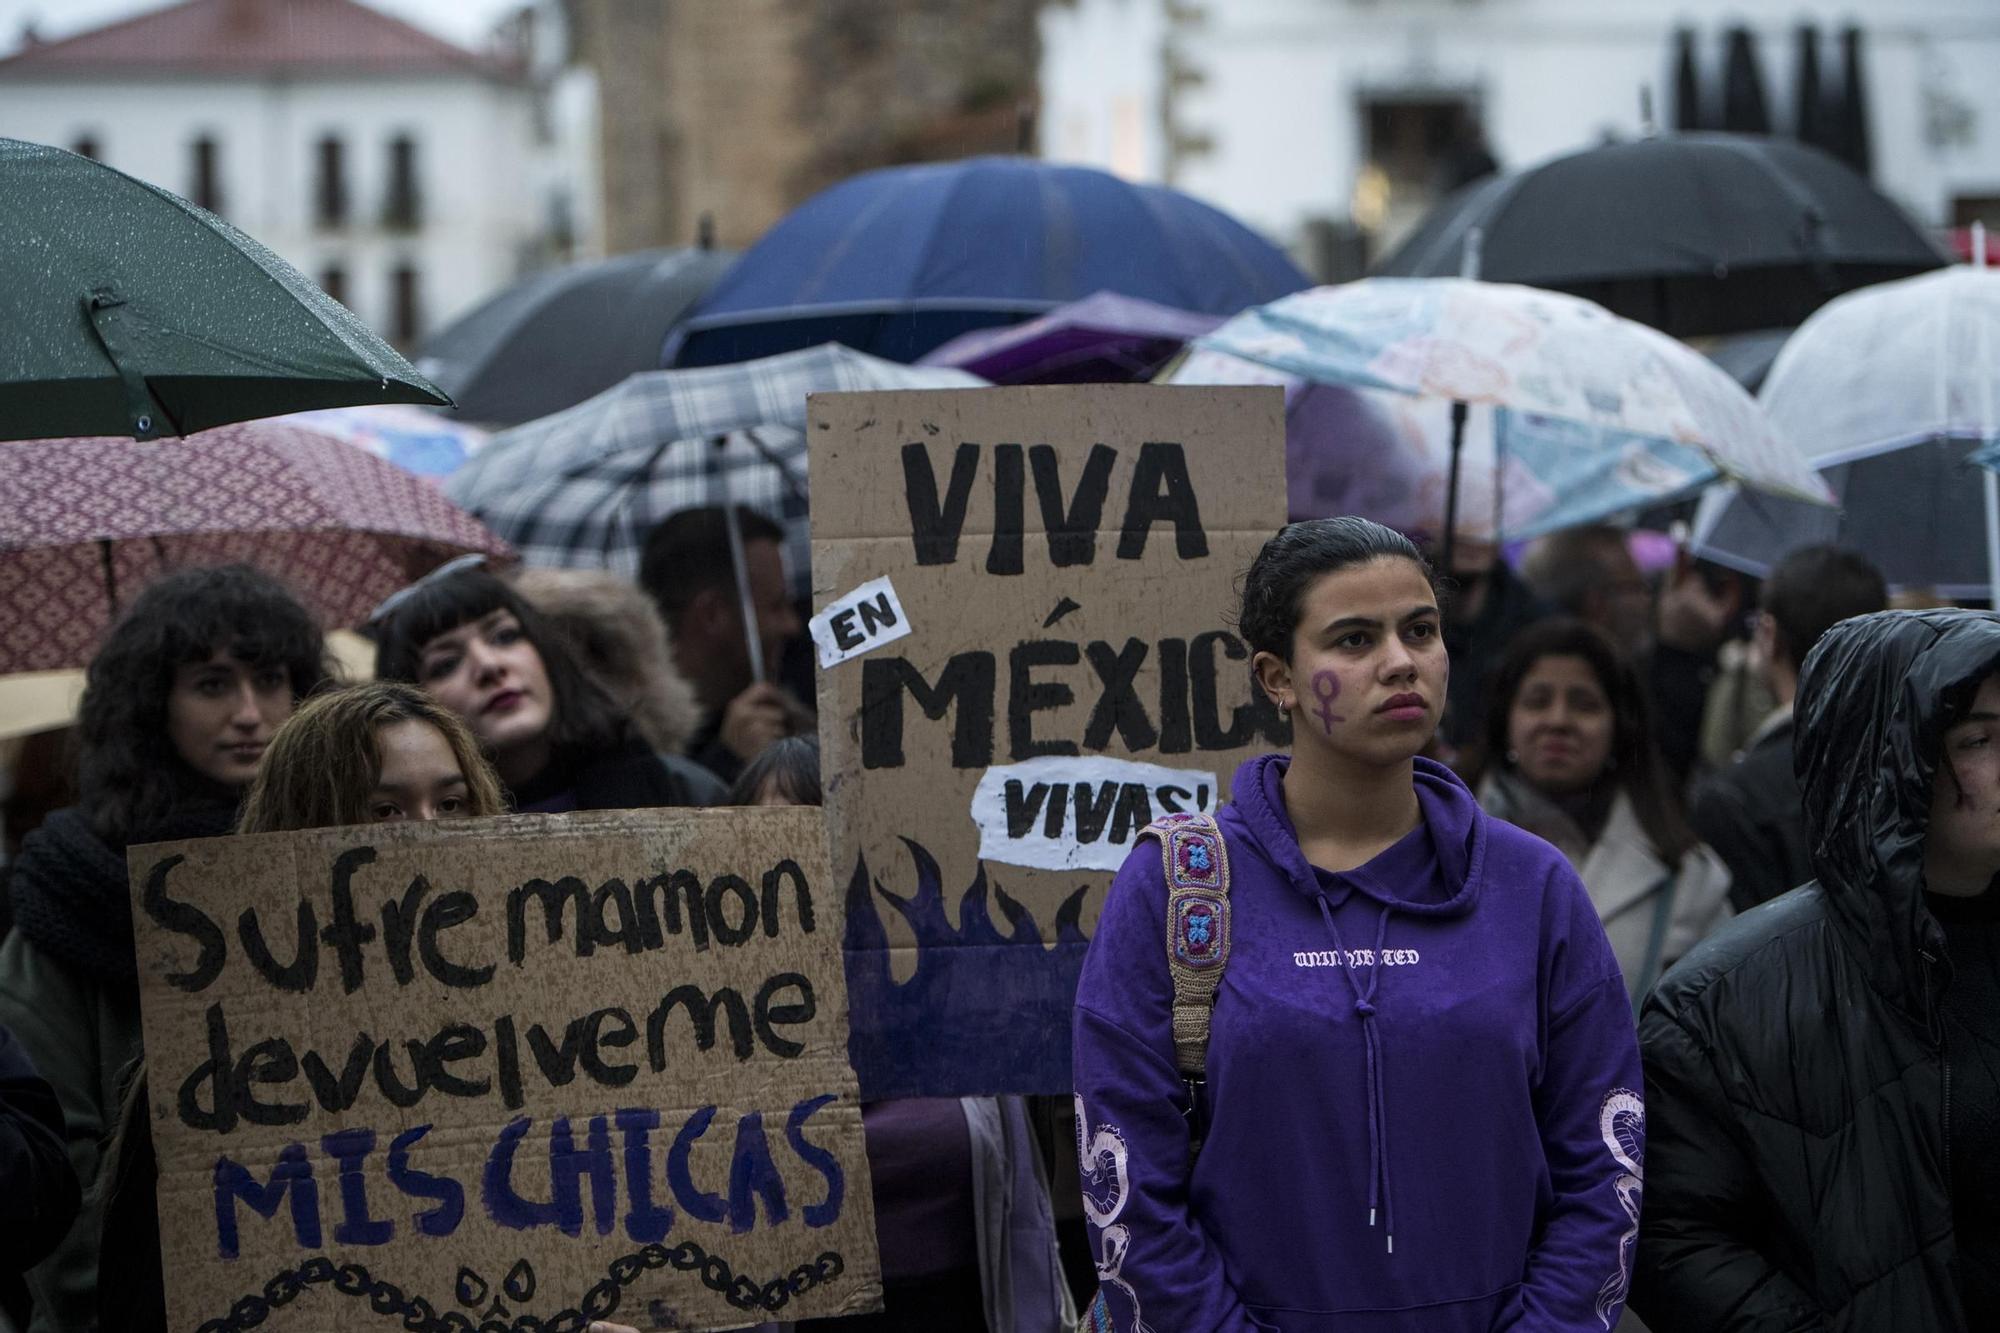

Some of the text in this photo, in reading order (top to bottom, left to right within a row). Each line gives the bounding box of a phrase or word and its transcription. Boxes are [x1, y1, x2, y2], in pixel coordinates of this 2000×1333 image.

[901, 442, 1210, 576] VIVA
[829, 591, 898, 651] EN
[142, 846, 815, 996] Sufre mamon
[177, 972, 816, 1135] devuelveme
[213, 1093, 844, 1260] MIS CHICAS
